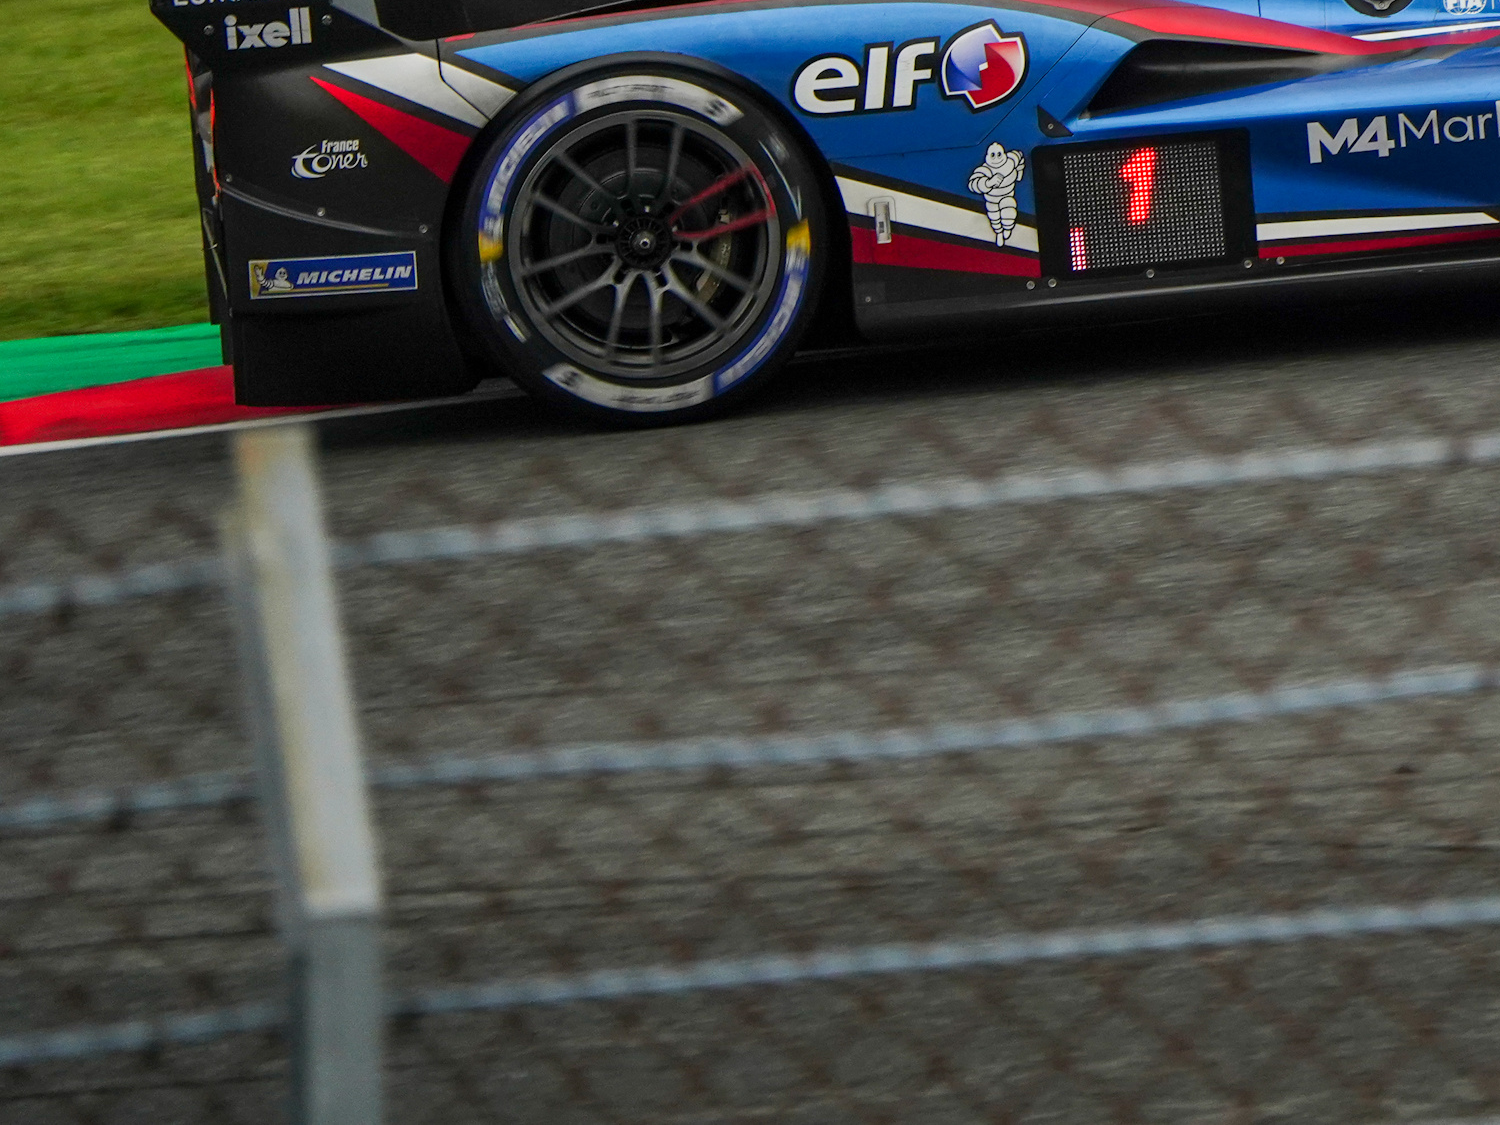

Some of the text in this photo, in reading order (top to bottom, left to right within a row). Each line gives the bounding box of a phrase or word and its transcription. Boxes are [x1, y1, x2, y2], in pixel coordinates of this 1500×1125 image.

[223, 6, 313, 52] ixell
[793, 40, 936, 115] elf
[320, 138, 360, 154] France
[1118, 146, 1157, 227] 1
[296, 264, 412, 286] MICHELIN
